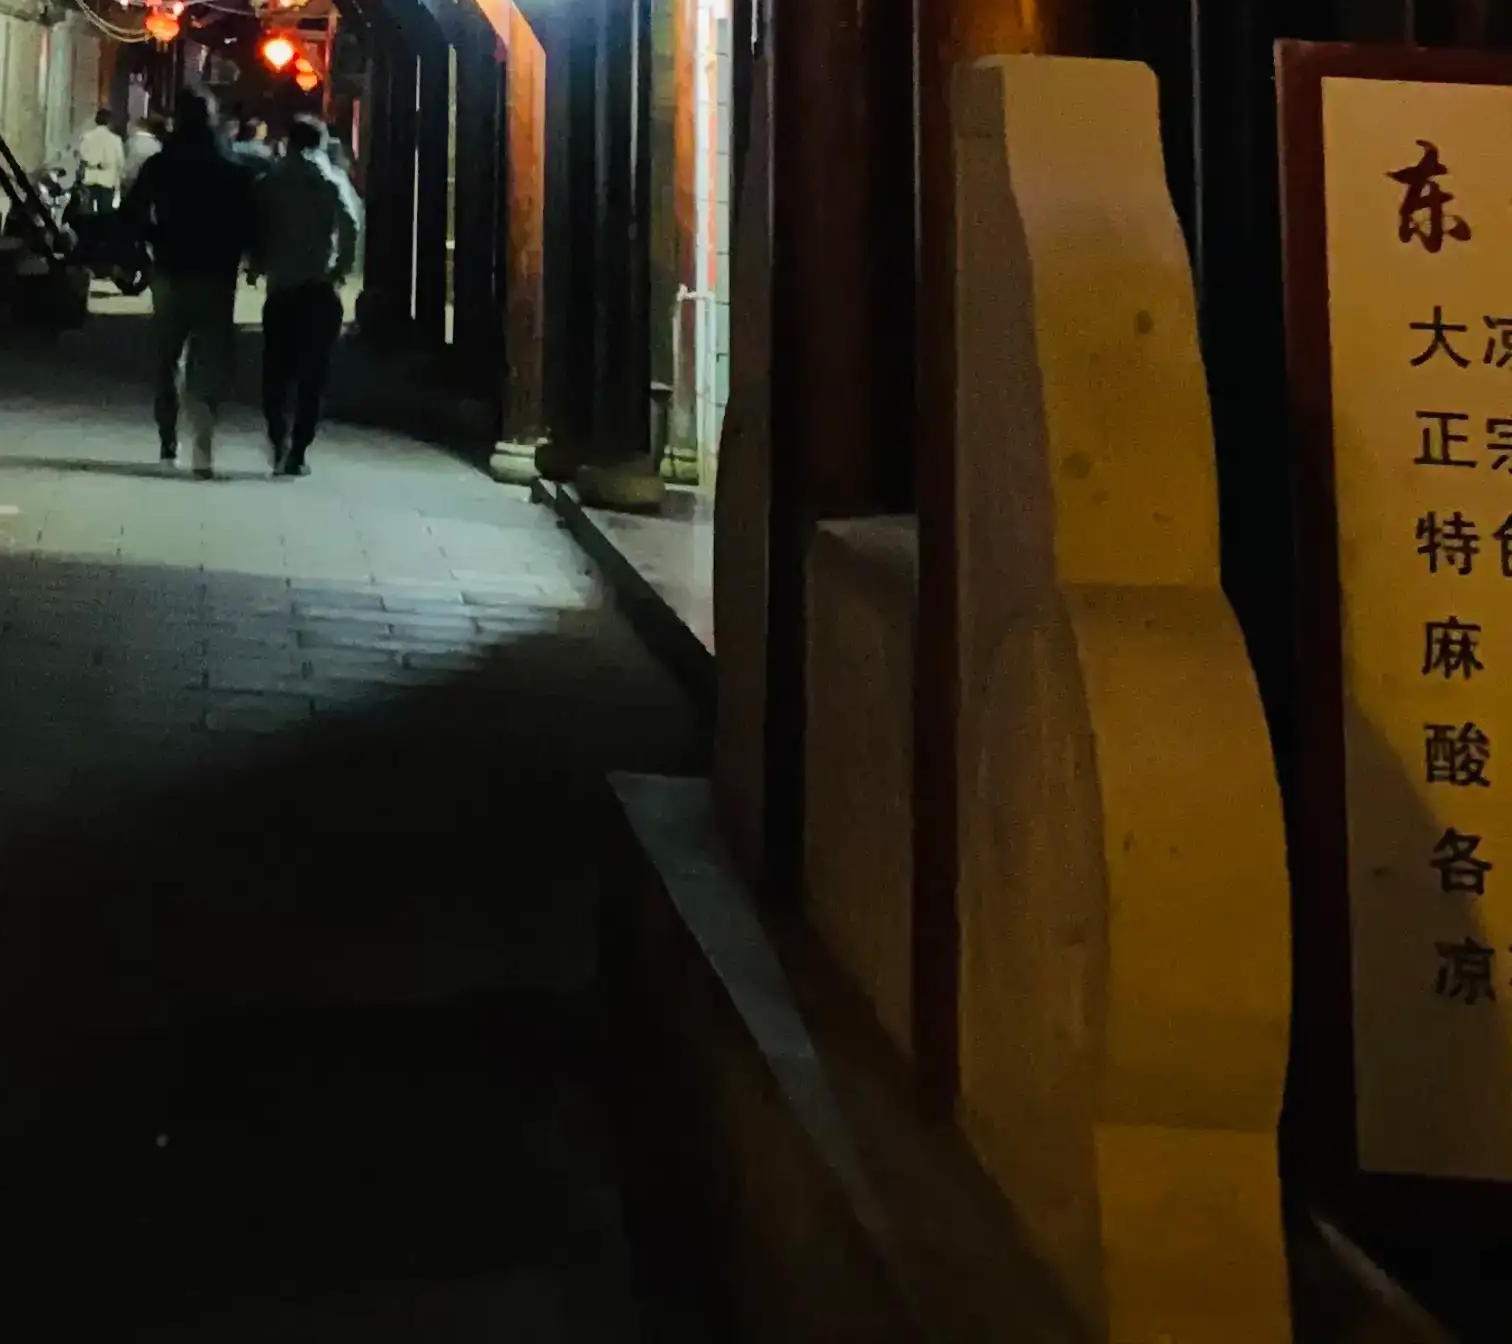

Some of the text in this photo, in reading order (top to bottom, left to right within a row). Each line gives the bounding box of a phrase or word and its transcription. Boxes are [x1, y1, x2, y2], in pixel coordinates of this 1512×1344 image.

[1386, 139, 1472, 254] 东
[1422, 615, 1484, 679] 麻
[1424, 722, 1491, 786] 酸
[1430, 827, 1493, 894] 各
[1434, 936, 1512, 1004] 凉
